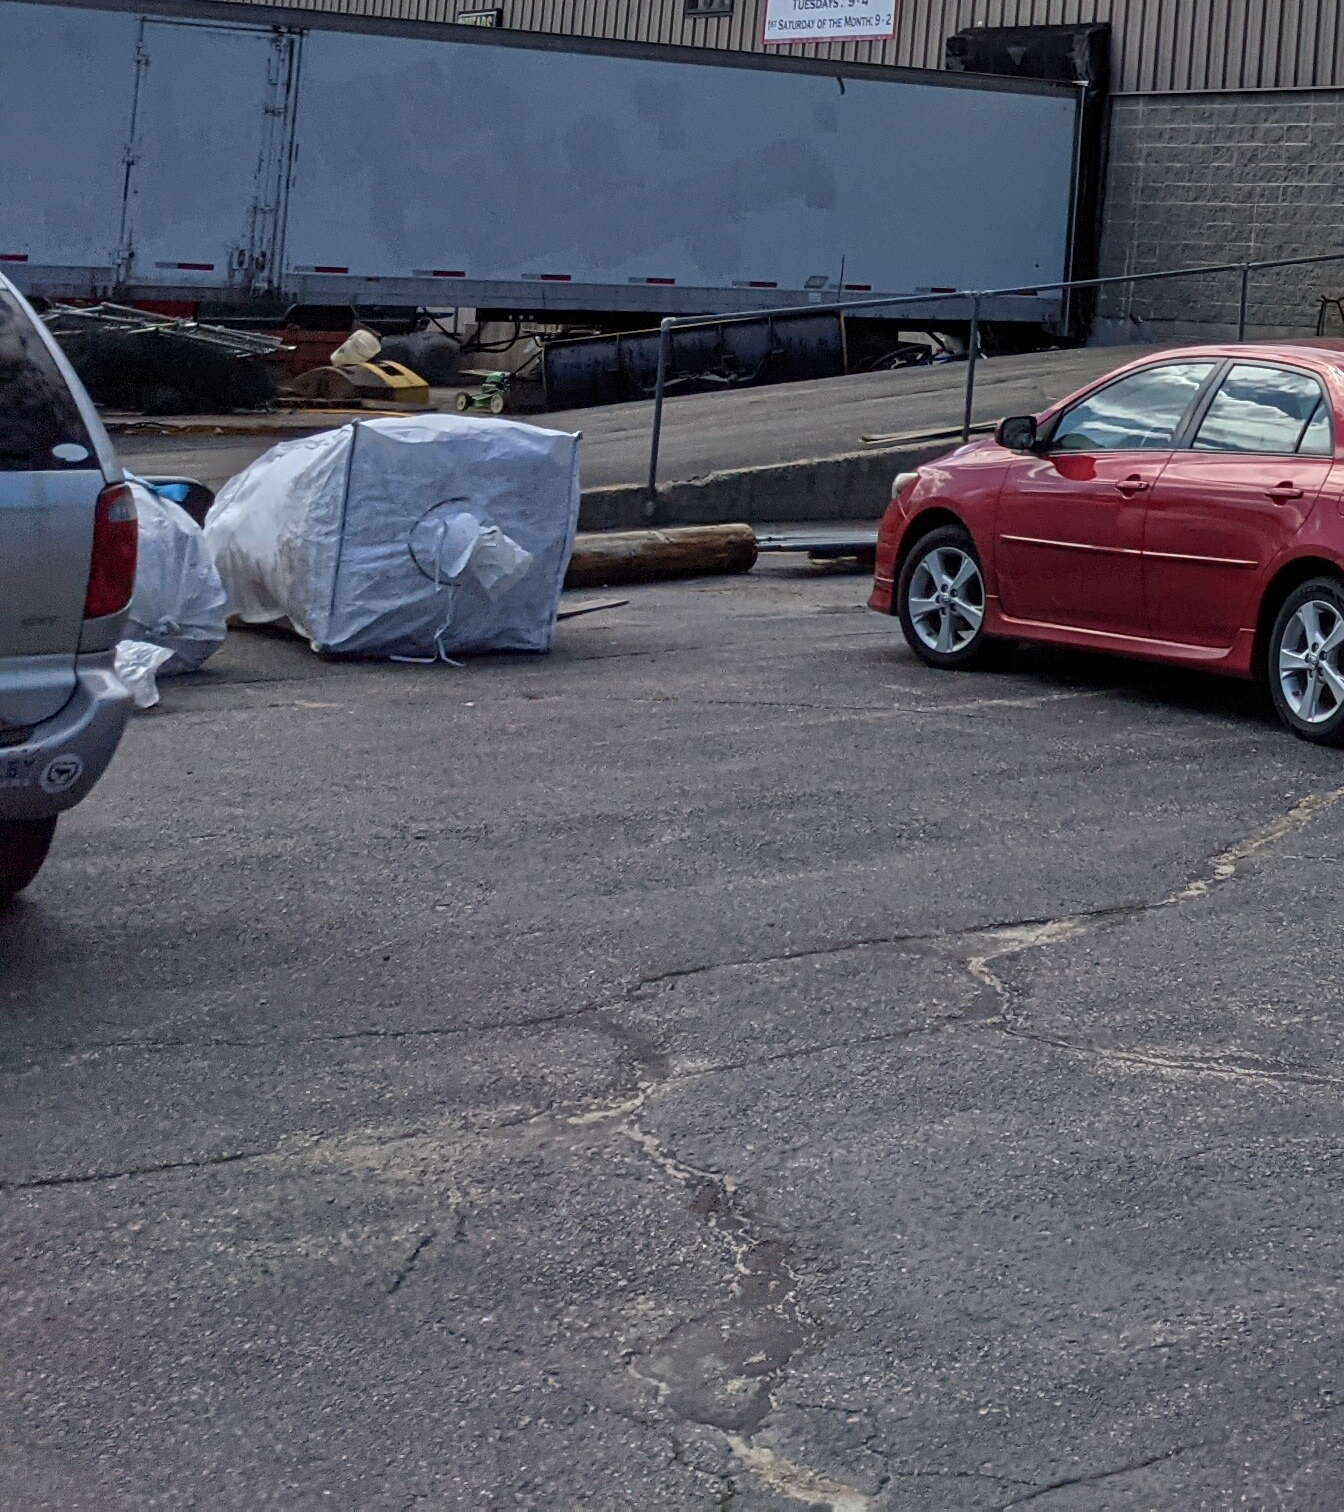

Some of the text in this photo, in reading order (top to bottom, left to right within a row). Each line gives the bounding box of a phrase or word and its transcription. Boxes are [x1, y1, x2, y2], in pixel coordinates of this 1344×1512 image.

[777, 19, 815, 31] SATURDAY
[817, 18, 827, 29] OF
[828, 17, 843, 28] THE
